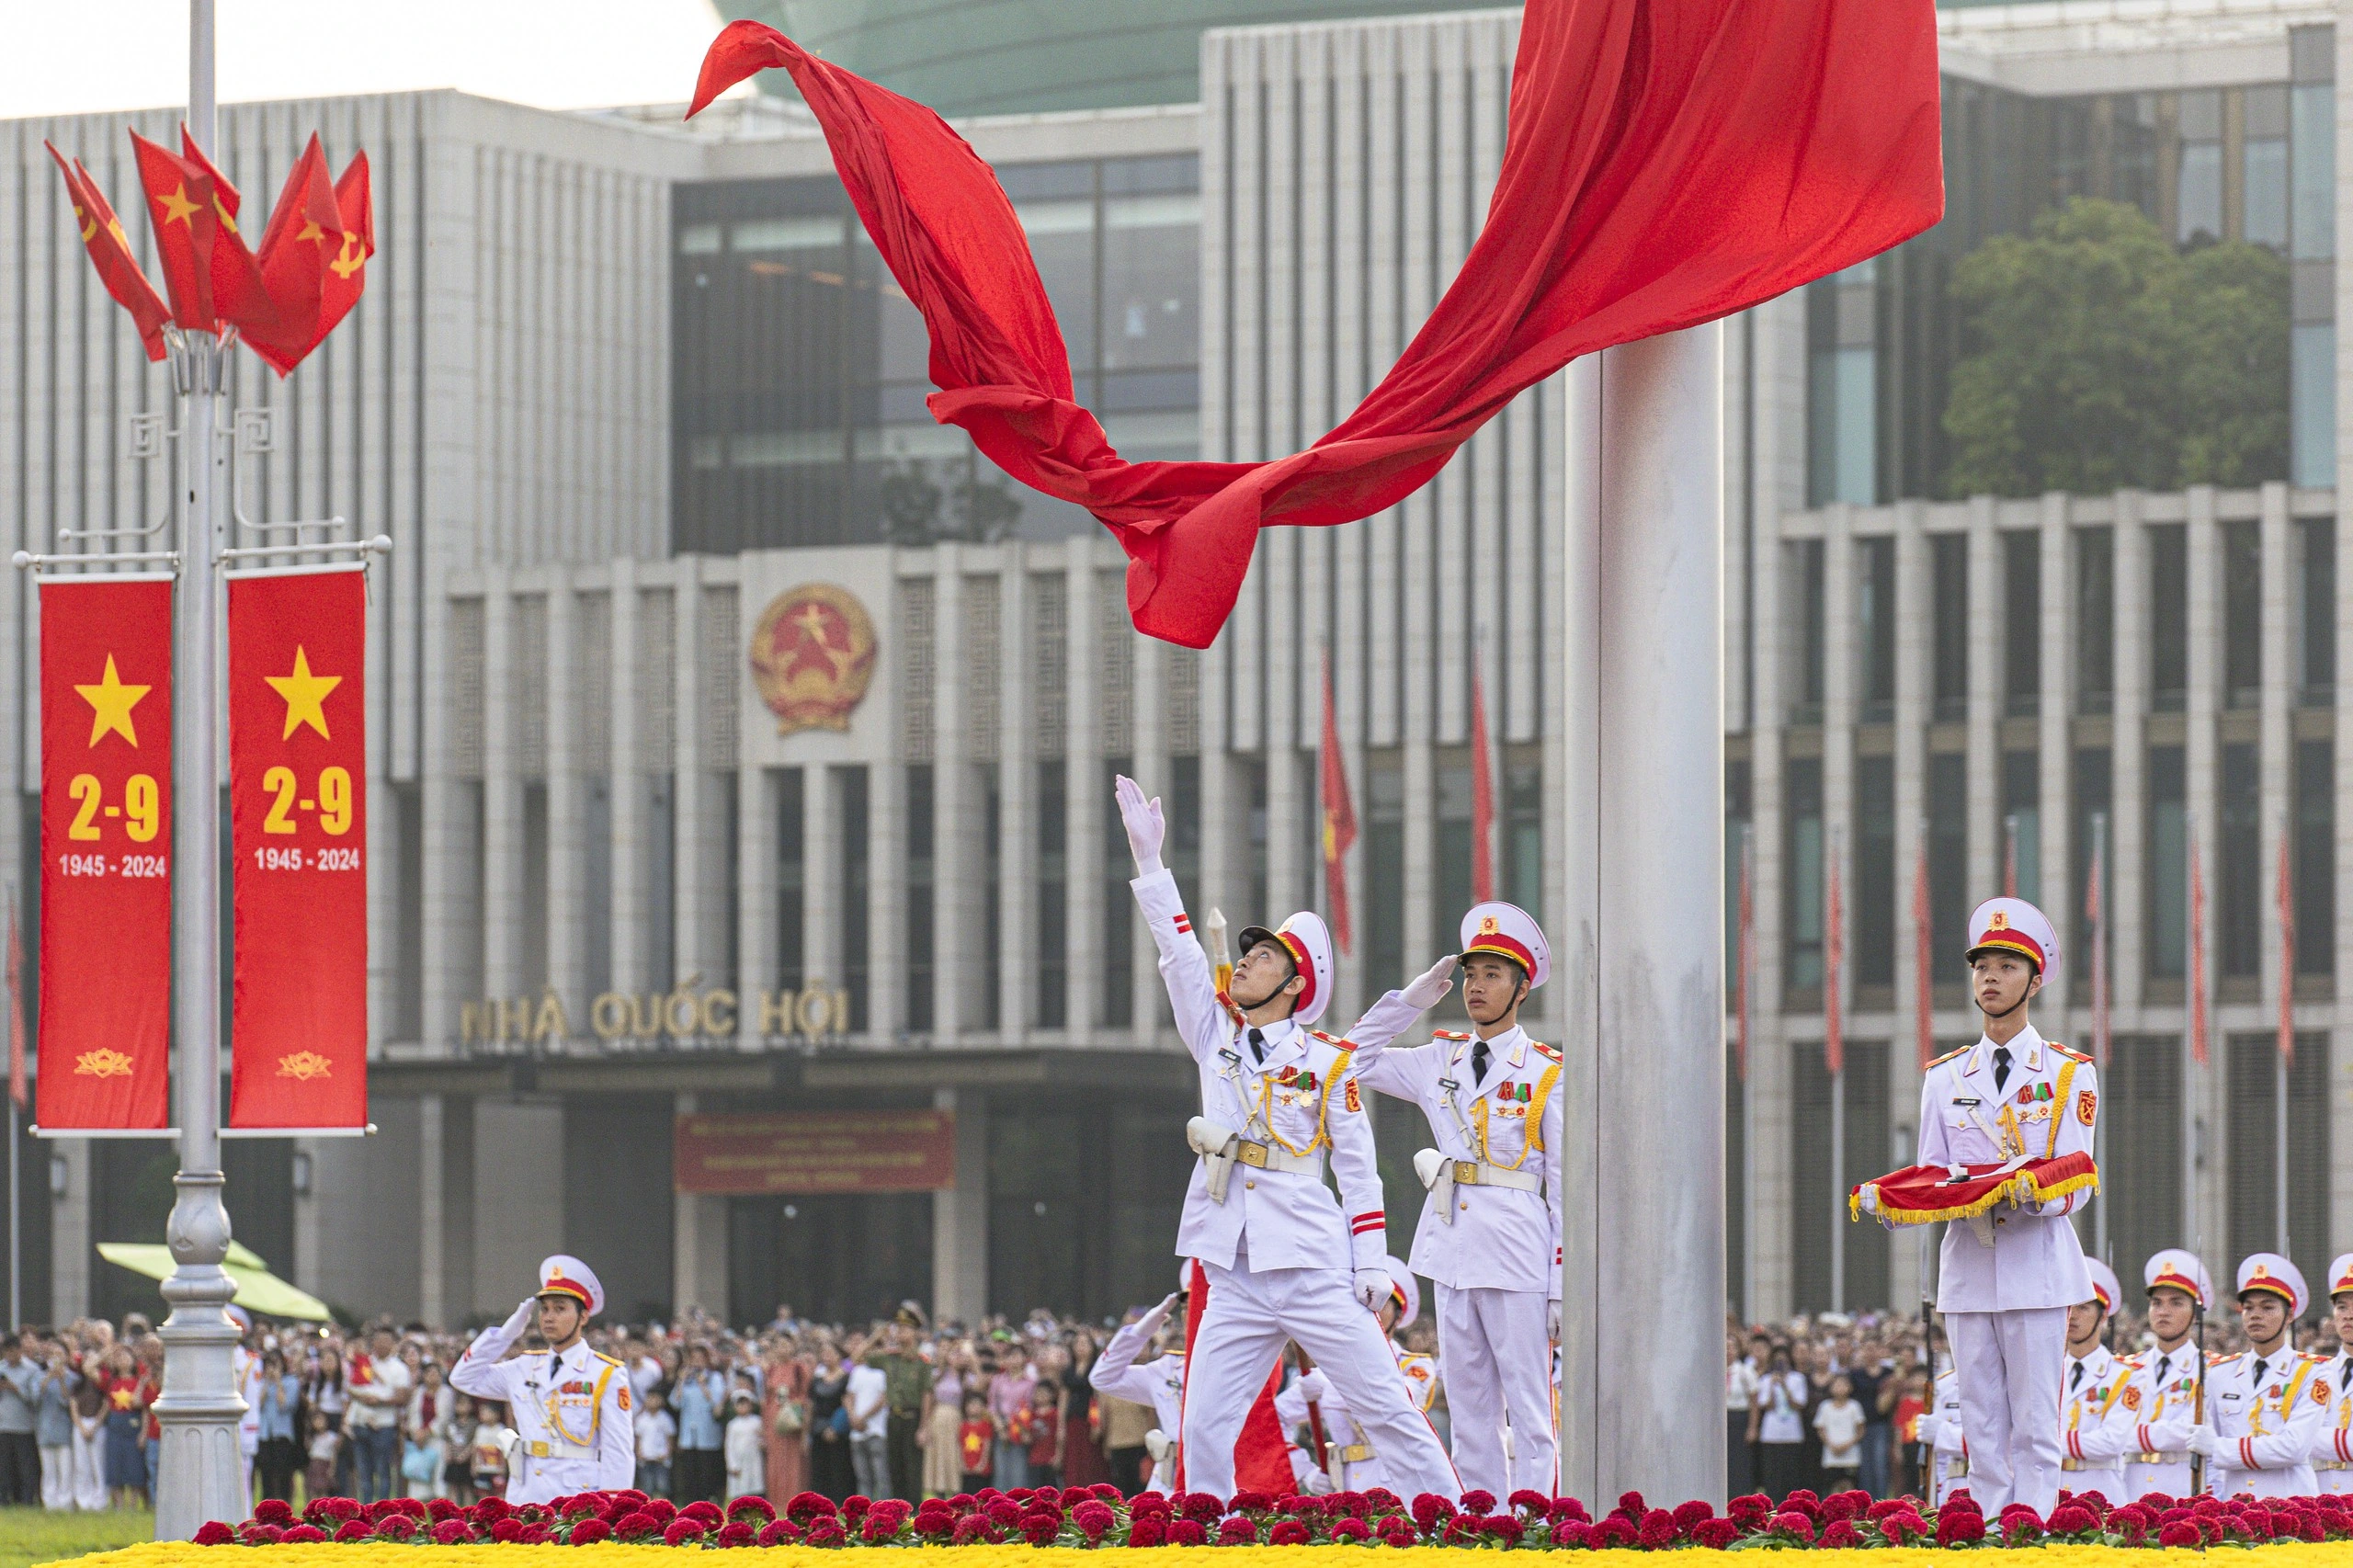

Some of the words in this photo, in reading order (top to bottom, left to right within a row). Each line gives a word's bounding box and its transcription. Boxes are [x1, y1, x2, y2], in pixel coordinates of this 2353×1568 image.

[69, 774, 158, 842] 2-9
[263, 766, 352, 835] 2-9
[59, 854, 106, 877] 1945
[121, 855, 165, 878] 2024
[254, 847, 301, 870] 1945
[317, 847, 359, 871] 2024
[461, 985, 569, 1042] NHÀ
[592, 973, 735, 1038] QUỐC
[759, 978, 848, 1043] HỘI
